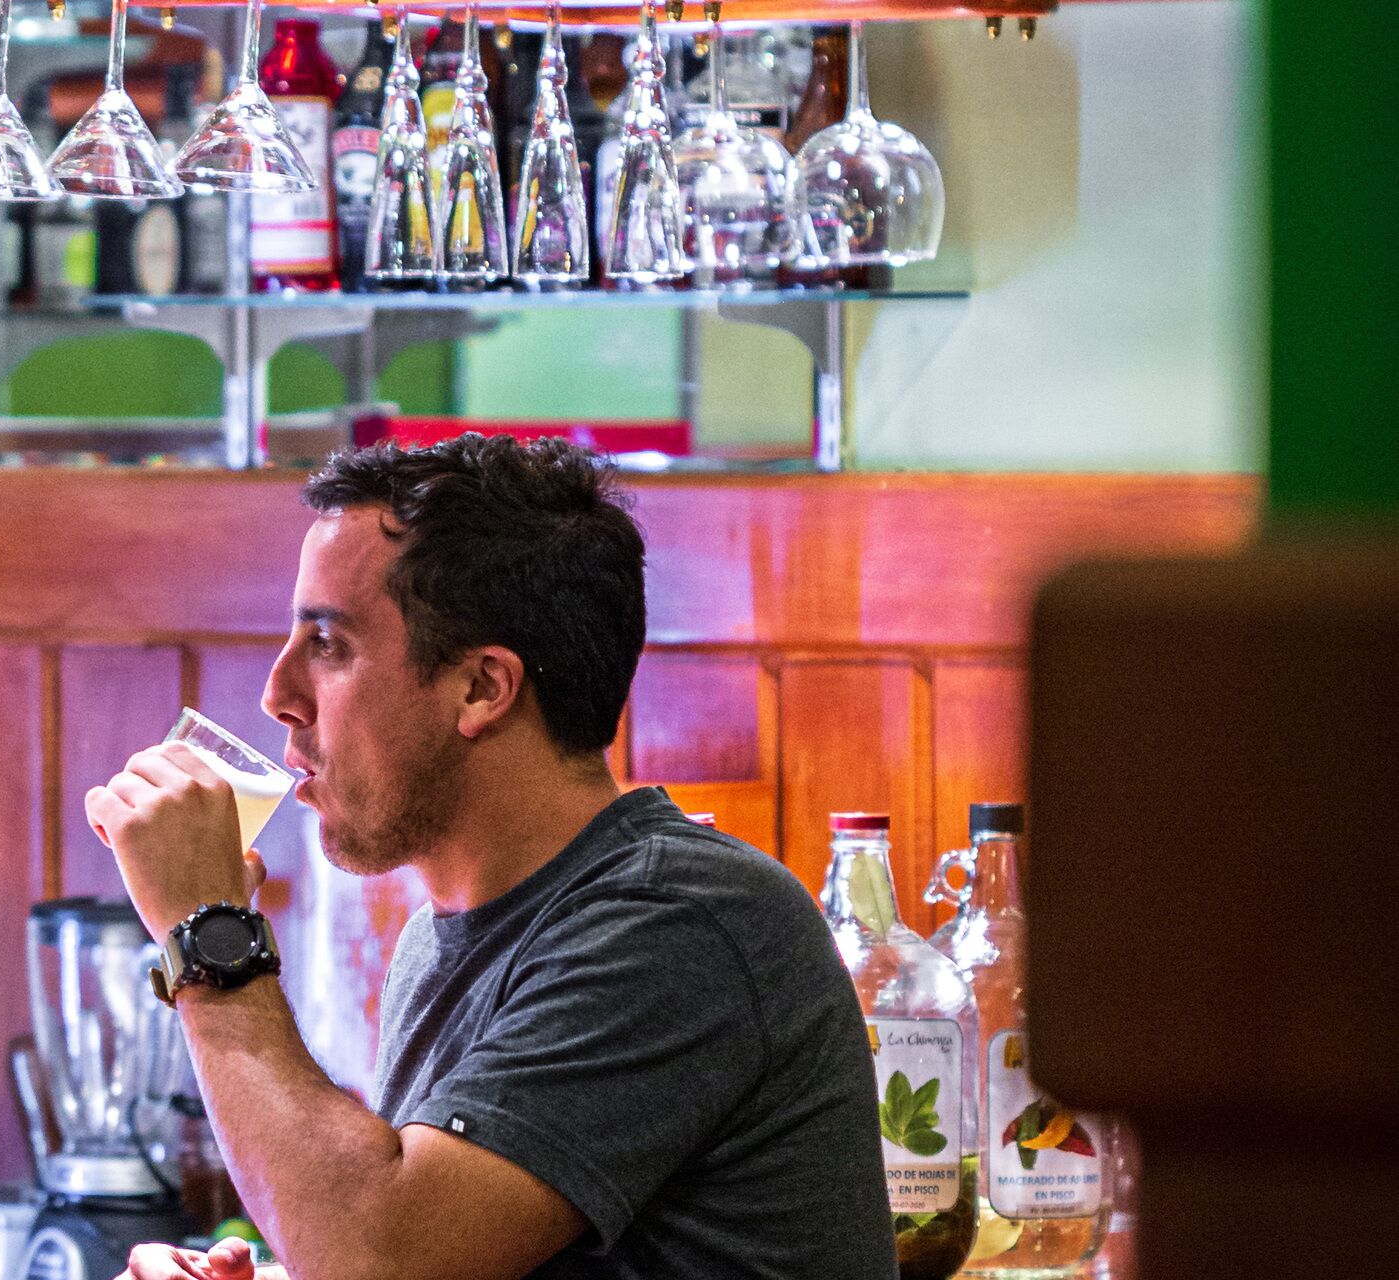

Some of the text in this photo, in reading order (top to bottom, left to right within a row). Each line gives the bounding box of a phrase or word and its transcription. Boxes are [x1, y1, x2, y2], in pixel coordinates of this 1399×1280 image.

[887, 1032, 904, 1046] La
[904, 1170, 917, 1179] DE
[919, 1170, 946, 1179] HOJAS
[997, 1175, 1056, 1186] MACERADO
[899, 1185, 912, 1195] EN
[914, 1185, 940, 1195] PISCO
[1035, 1190, 1075, 1200] EN PISCO
